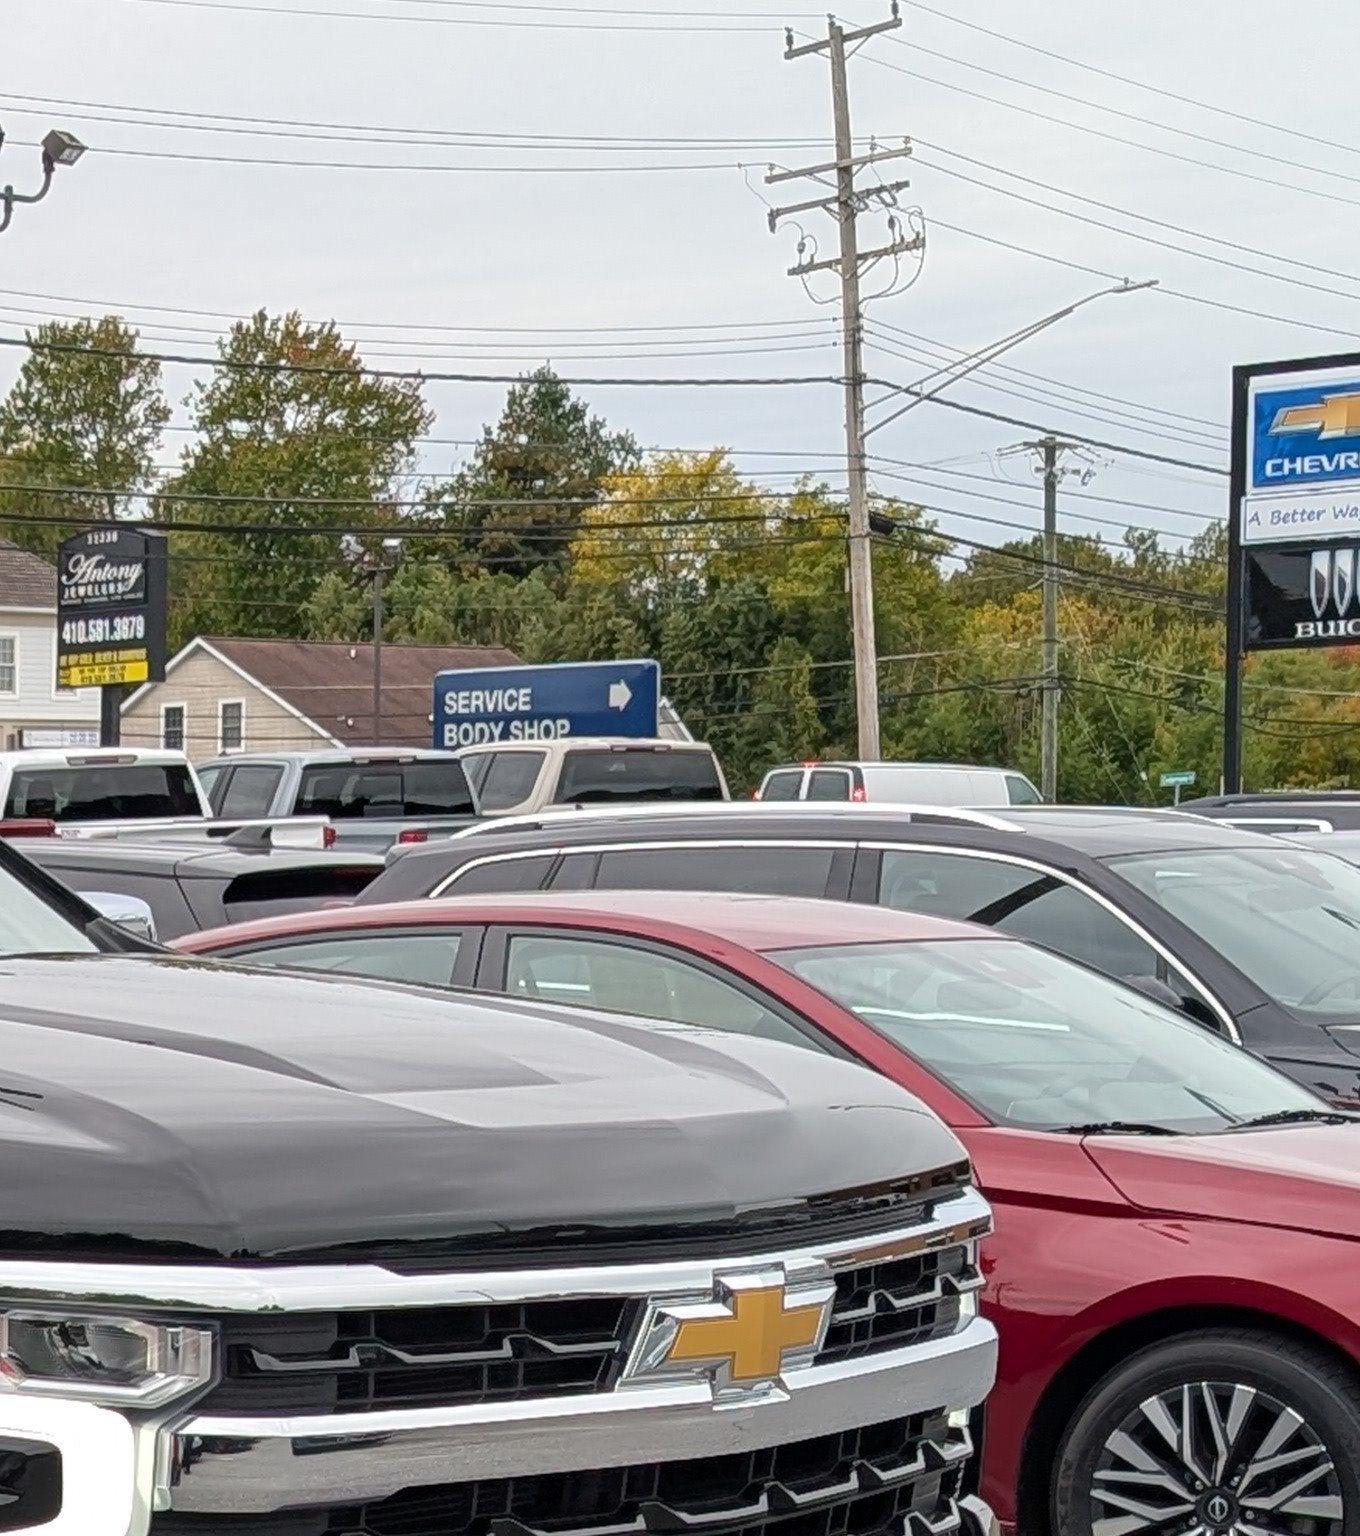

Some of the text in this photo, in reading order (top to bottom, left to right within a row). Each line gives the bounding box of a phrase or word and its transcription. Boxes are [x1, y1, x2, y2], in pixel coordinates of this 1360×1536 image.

[1248, 504, 1360, 526] A Better Wa
[443, 687, 532, 714] SERVICE
[443, 718, 571, 747] BODY SHOP
